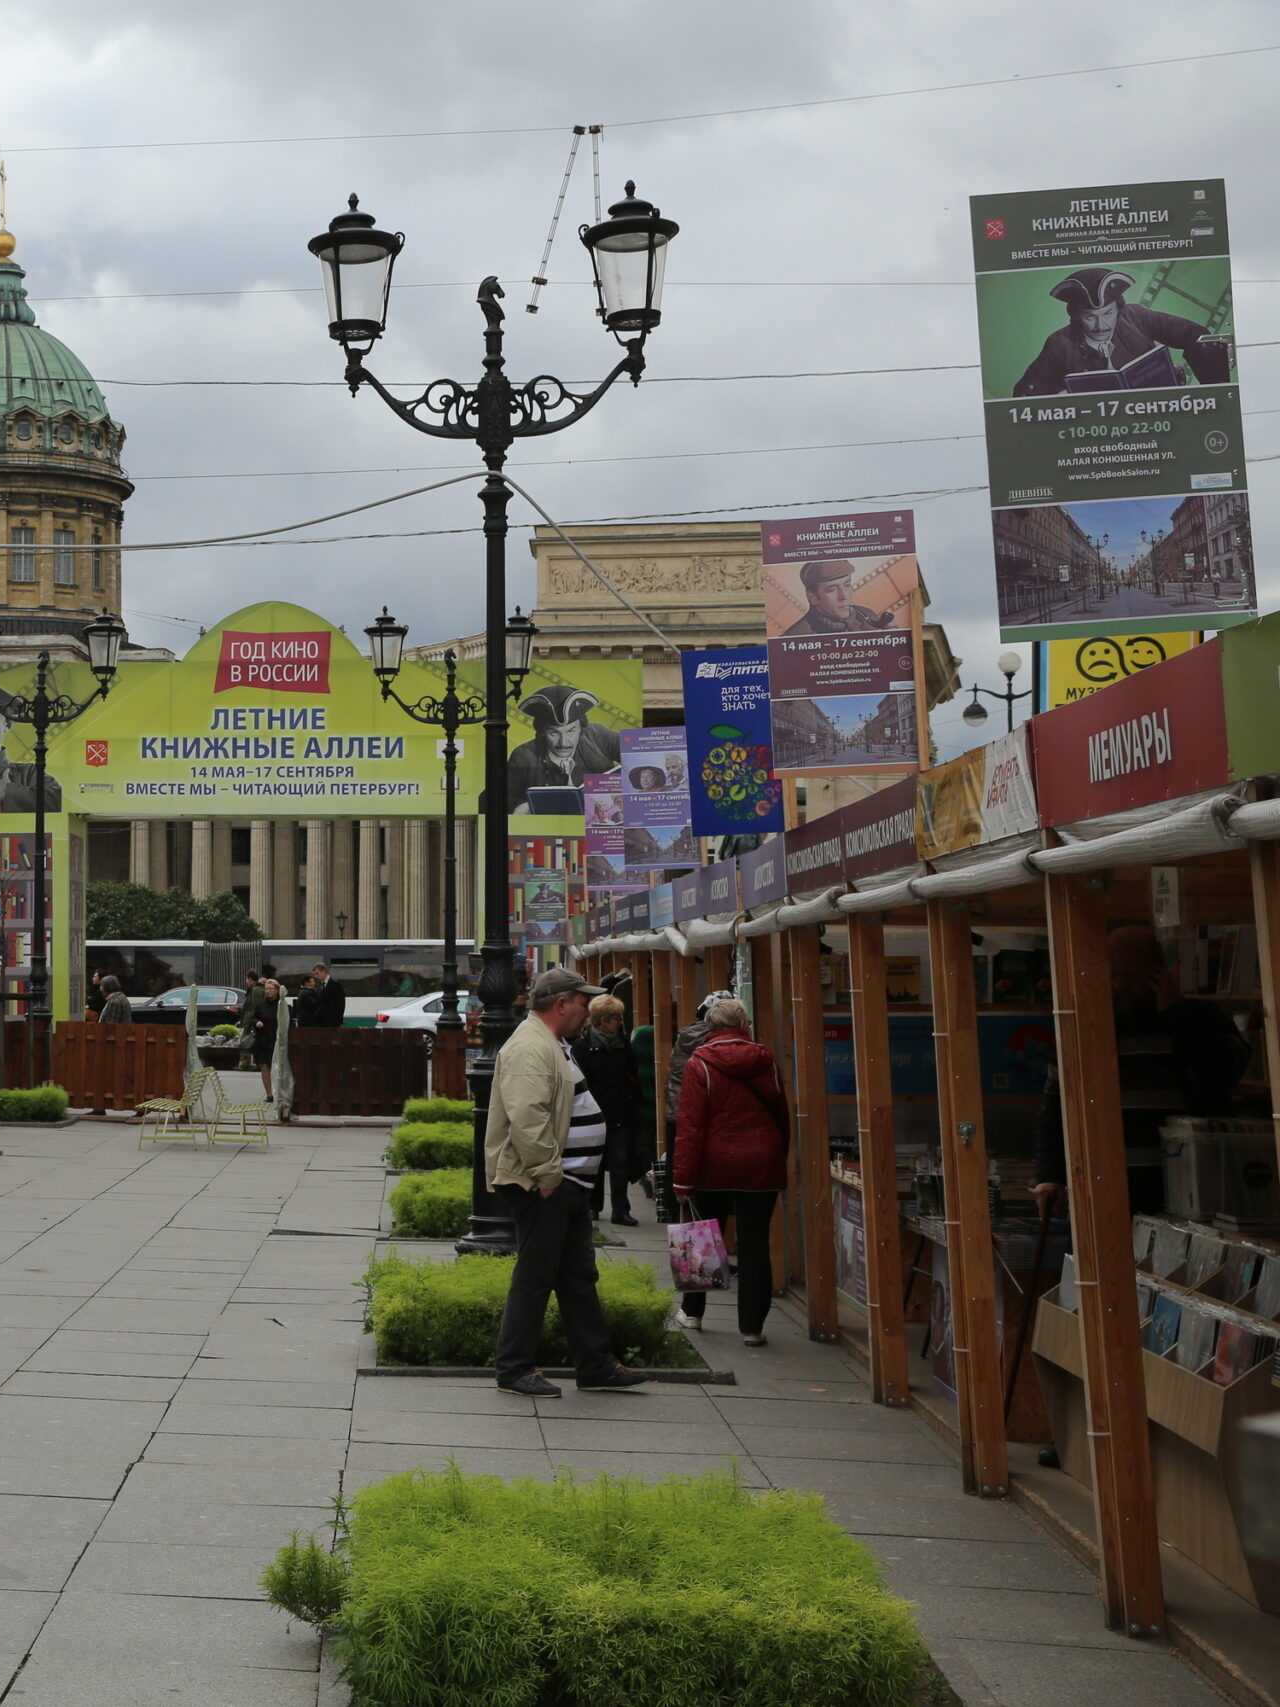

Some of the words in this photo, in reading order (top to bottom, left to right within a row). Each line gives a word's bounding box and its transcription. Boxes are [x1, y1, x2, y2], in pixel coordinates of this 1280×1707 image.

[1070, 197, 1129, 213] ЛЕТНИЕ
[1032, 213, 1114, 231] КНИЖНЫЕ
[1117, 209, 1169, 224] АЛЛЕИ
[1110, 225, 1147, 235] ПИСАТЕЛЕЙ
[1011, 249, 1050, 260] ВМЕСТЕ
[1051, 247, 1069, 257] МЫ
[1077, 241, 1137, 256] ЧИТАЮЩИЙ
[1138, 239, 1194, 251] ПЕТЕРБУРГ!
[1009, 406, 1032, 423] 14
[1037, 406, 1076, 421] мая
[1097, 401, 1120, 417] 17
[1124, 394, 1216, 415] сентября
[1058, 429, 1065, 439] с
[1069, 424, 1108, 438] 10-00
[1110, 425, 1128, 437] до
[1131, 420, 1170, 434] 22-00
[1074, 444, 1099, 455] вход
[1100, 439, 1158, 453] свободный
[1208, 437, 1225, 448] 0+
[1057, 457, 1091, 467] МАЛАЯ
[1092, 452, 1160, 465] КОНЮШЕННАЯ
[1161, 451, 1176, 460] УЛ.
[1068, 467, 1160, 481] www.SpbBookSalon.ru
[1008, 488, 1054, 500] ДНЕВНИК
[819, 521, 856, 531] ЛЕТНИЕ
[796, 530, 846, 542] КНИЖНЫЕ
[847, 528, 879, 537] АЛЛЕИ
[823, 547, 859, 555] ЧИТАЮЩИЙ
[860, 544, 894, 552] ПЕТЕРБУРГ!
[782, 641, 795, 651] 14
[798, 641, 821, 650] мая
[833, 638, 848, 648] 17
[850, 635, 907, 647] сентября
[230, 642, 265, 663] ГОД
[271, 641, 318, 659] КИНО
[818, 652, 840, 660] 10-00
[854, 650, 878, 658] 22-00
[230, 665, 242, 682] В
[248, 664, 318, 682] РОССИИ
[721, 687, 739, 695] для
[742, 692, 771, 701] хочет
[722, 701, 756, 712] ЗНАТЬ
[210, 708, 325, 731] ЛЕТНИЕ
[141, 737, 295, 759] КНИЖНЫЕ
[304, 737, 404, 759] АЛЛЕИ
[1088, 708, 1172, 784] МЕМУАРЫ
[190, 766, 208, 778] 14
[276, 766, 354, 778] СЕНТЯБРЯ
[125, 783, 186, 795] ВМЕСТЕ
[189, 783, 216, 795] МЫ
[232, 781, 325, 798] ЧИТАЮЩИЙ
[330, 783, 420, 796] ПЕТЕРБУРГ!
[845, 816, 894, 859] КОМСОМОЛЬСКАЯ
[787, 841, 823, 876] КОМСОМОЛЬСКАЯ
[823, 836, 842, 867] ПРАВДА
